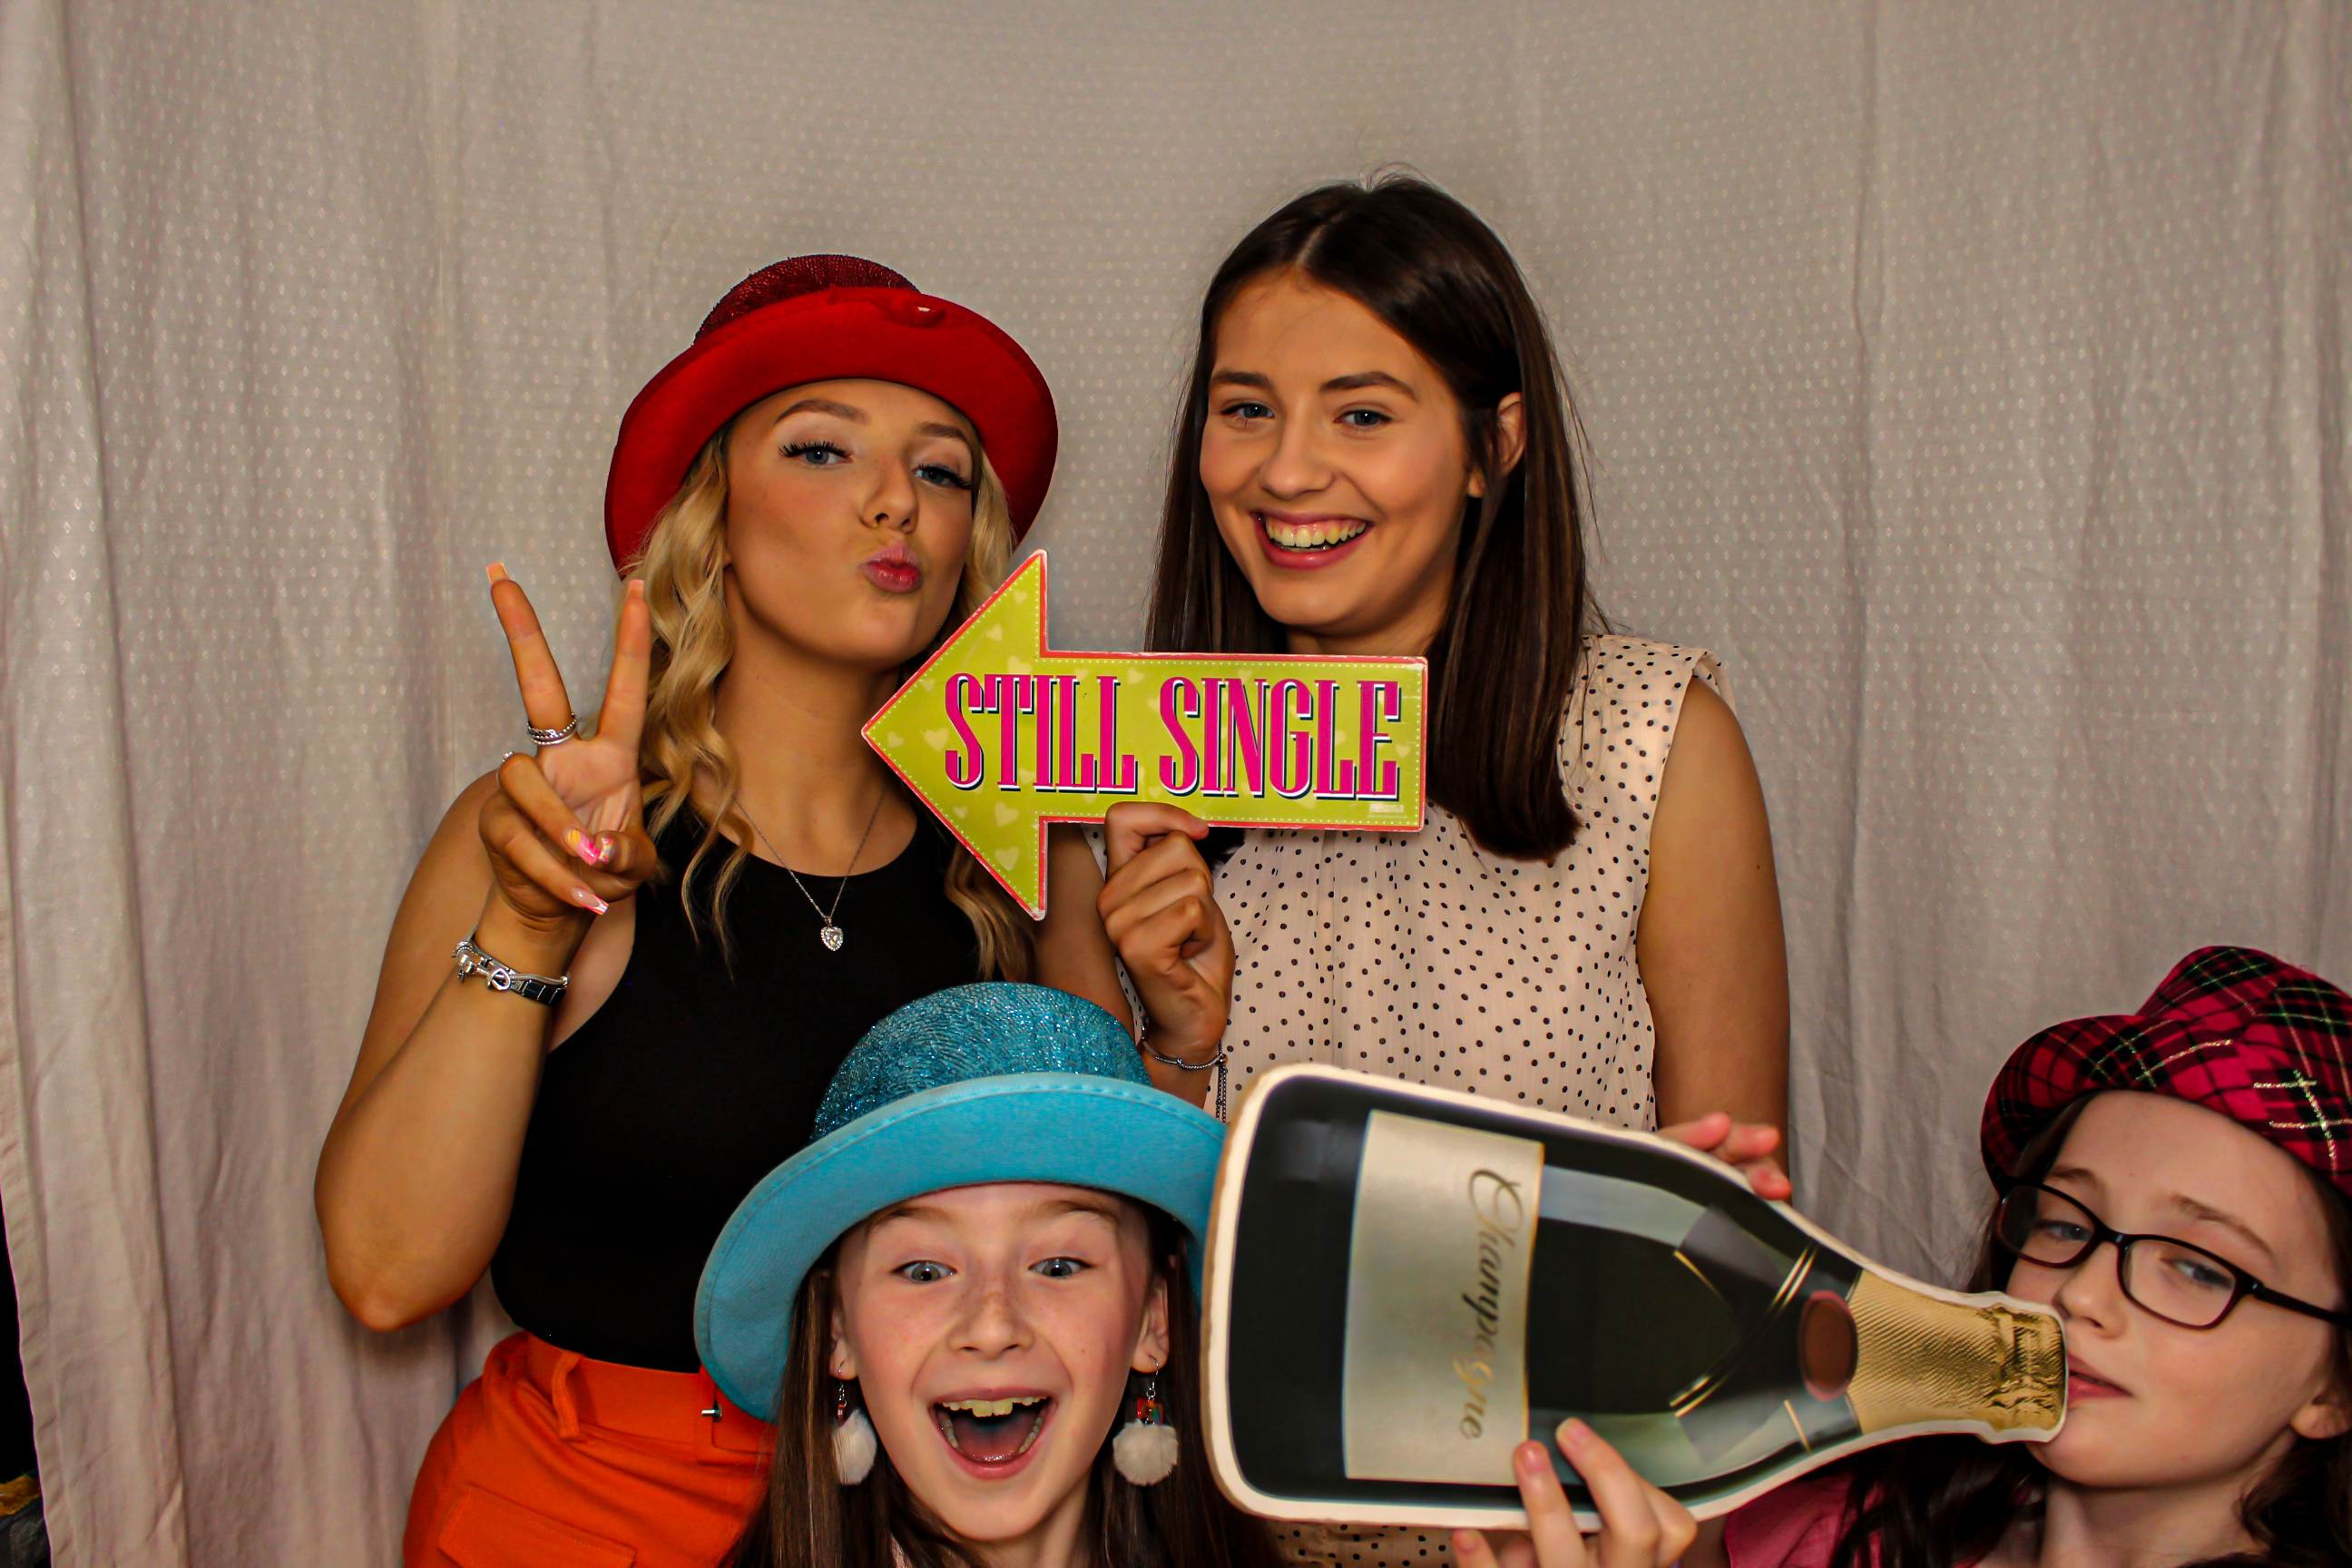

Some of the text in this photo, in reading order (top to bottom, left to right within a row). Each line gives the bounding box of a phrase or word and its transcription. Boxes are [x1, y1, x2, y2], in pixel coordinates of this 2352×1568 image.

[945, 671, 1401, 802] STILL SINGLE
[1454, 1168, 1524, 1440] Champagne
